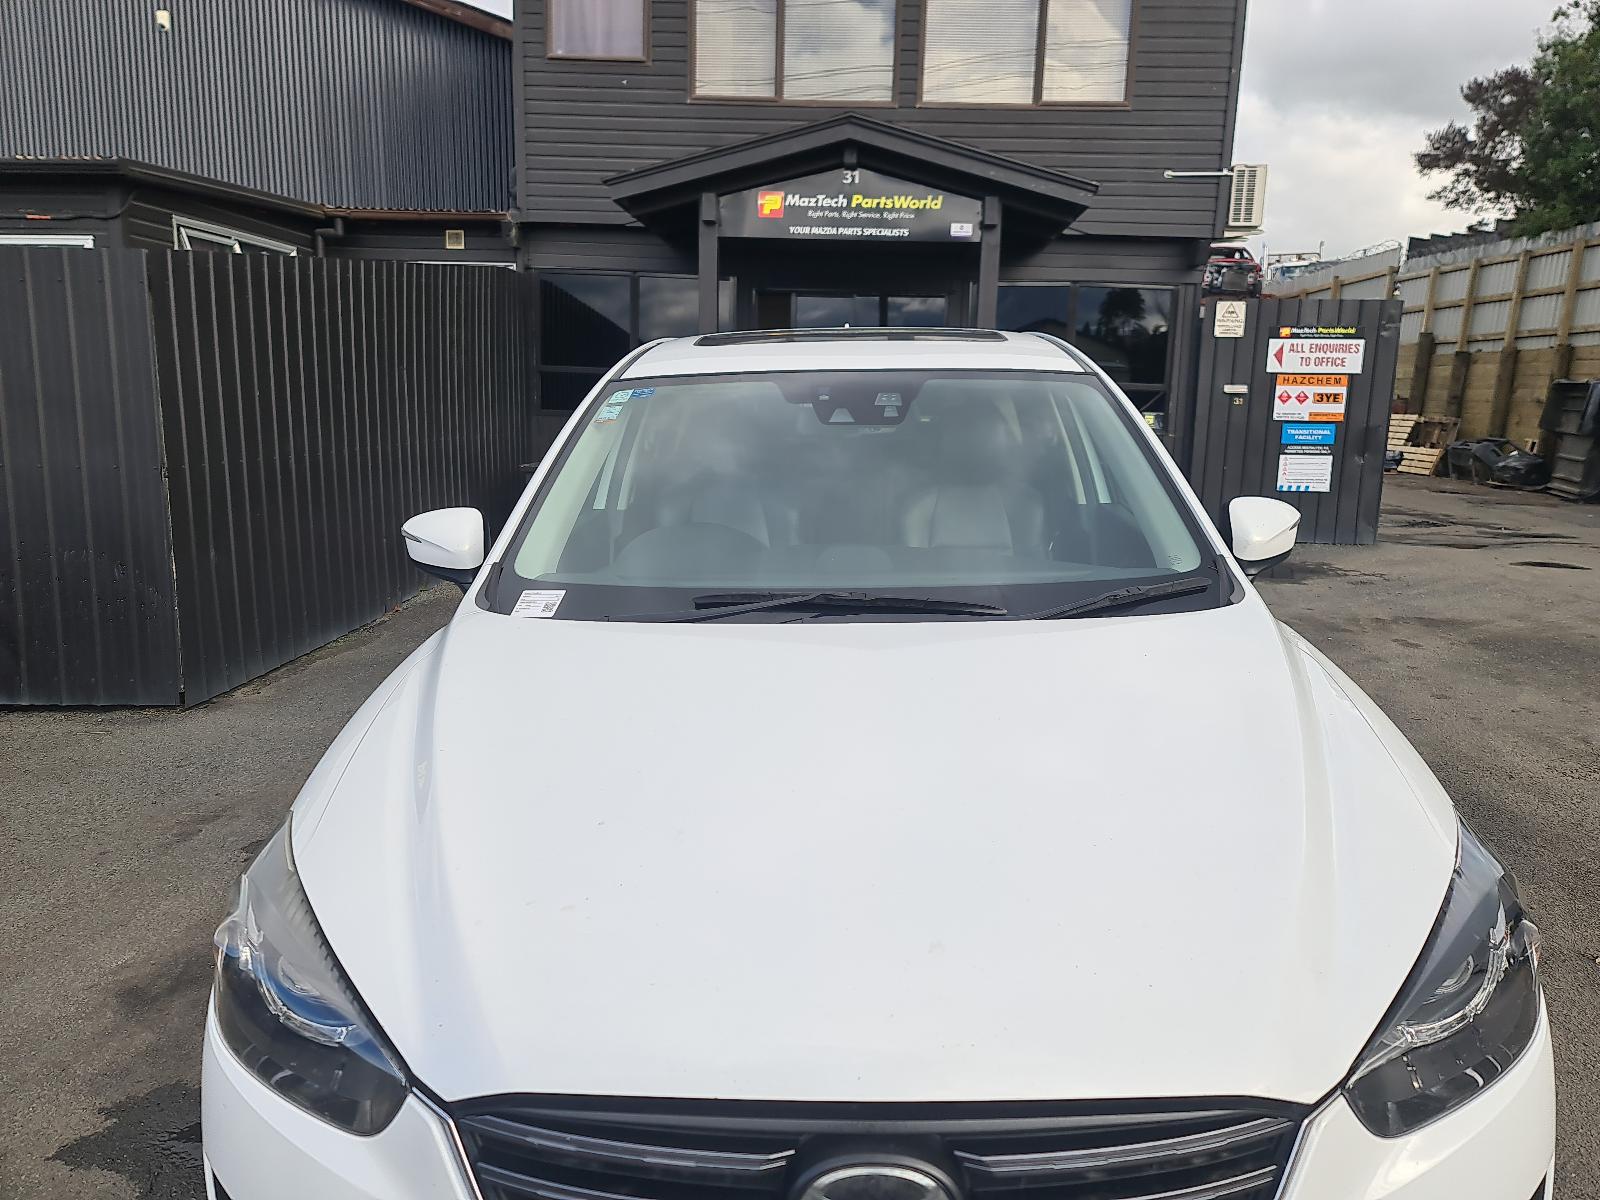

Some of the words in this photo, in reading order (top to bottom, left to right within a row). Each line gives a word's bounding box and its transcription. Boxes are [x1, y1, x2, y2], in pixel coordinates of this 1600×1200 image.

[842, 170, 860, 184] 31
[785, 194, 848, 207] MazTech
[851, 195, 943, 209] PartsWorld
[789, 226, 810, 235] YOUR
[811, 226, 837, 235] MAZDA
[838, 227, 862, 236] PARTS
[862, 227, 909, 237] SPECIALISTS
[1288, 343, 1305, 354] ALL
[1309, 343, 1360, 355] ENQUIRIES
[1299, 357, 1311, 367] TO
[1314, 357, 1347, 368] OFFICE
[1282, 376, 1342, 385] HAZCHEM
[1316, 393, 1341, 403] 3YE
